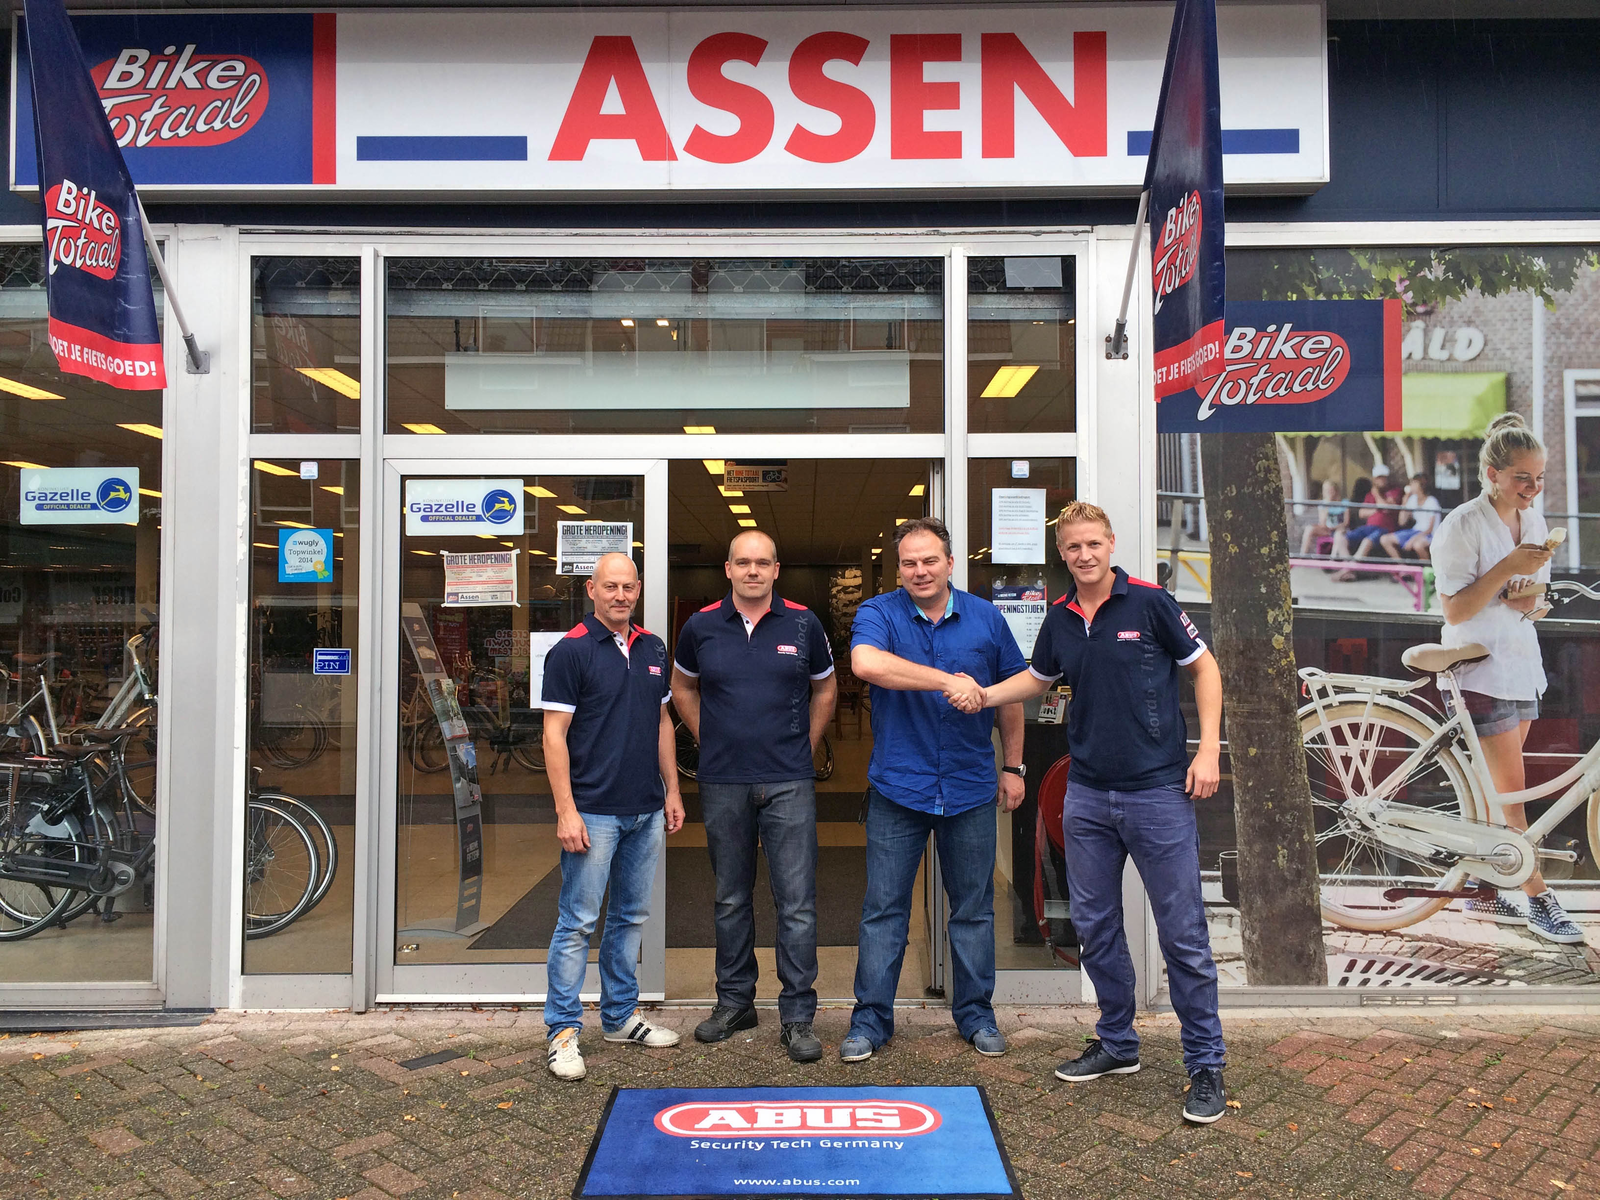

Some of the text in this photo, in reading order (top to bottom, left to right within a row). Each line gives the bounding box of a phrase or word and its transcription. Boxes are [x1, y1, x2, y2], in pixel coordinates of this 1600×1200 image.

[102, 44, 247, 90] Bike
[547, 31, 1107, 163] ASSEN
[56, 178, 115, 235] Bike
[1163, 191, 1197, 248] Bike
[47, 218, 120, 276] Totaal
[1154, 203, 1200, 315] Totaal
[70, 343, 82, 362] JE
[83, 347, 107, 371] FIETS
[107, 356, 157, 376] GOED!
[1224, 323, 1332, 360] Bike
[1168, 362, 1179, 381] JE
[1180, 353, 1196, 377] FIETS
[1195, 340, 1220, 368] GOED!
[1196, 346, 1344, 421] Totaal
[25, 489, 91, 502] Gazelle
[410, 501, 476, 513] Gazelle
[562, 525, 628, 535] GROTE HEROPENING!
[446, 553, 512, 565] GROTE HEROPENING!
[315, 661, 340, 669] PIN
[1145, 689, 1161, 738] Bordo
[693, 1107, 901, 1129] ABUS
[690, 1138, 905, 1152] Security Tech Germany
[733, 1176, 860, 1187] www.abus.com
